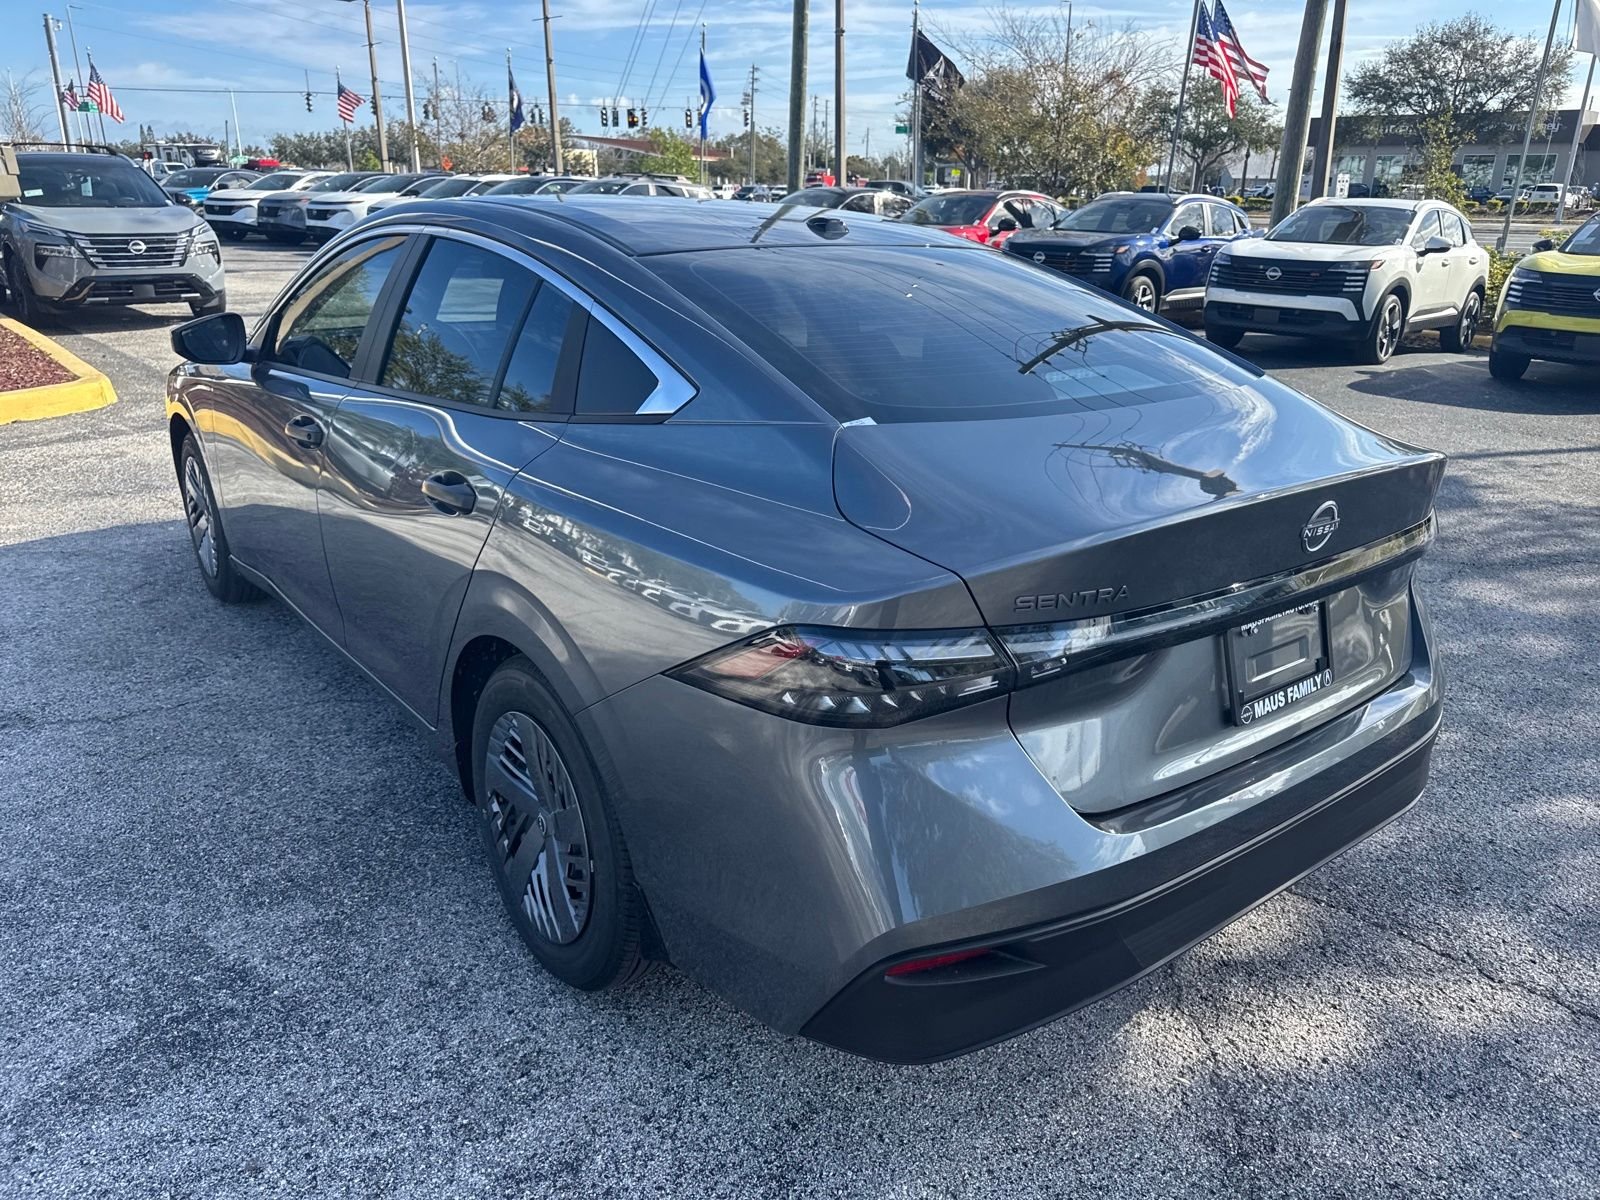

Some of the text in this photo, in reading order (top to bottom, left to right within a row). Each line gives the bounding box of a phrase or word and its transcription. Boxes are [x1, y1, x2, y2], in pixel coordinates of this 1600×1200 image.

[1303, 521, 1339, 538] NISSAN
[1013, 585, 1129, 612] SENTRA
[1254, 673, 1322, 718] MAUS FAMILY
